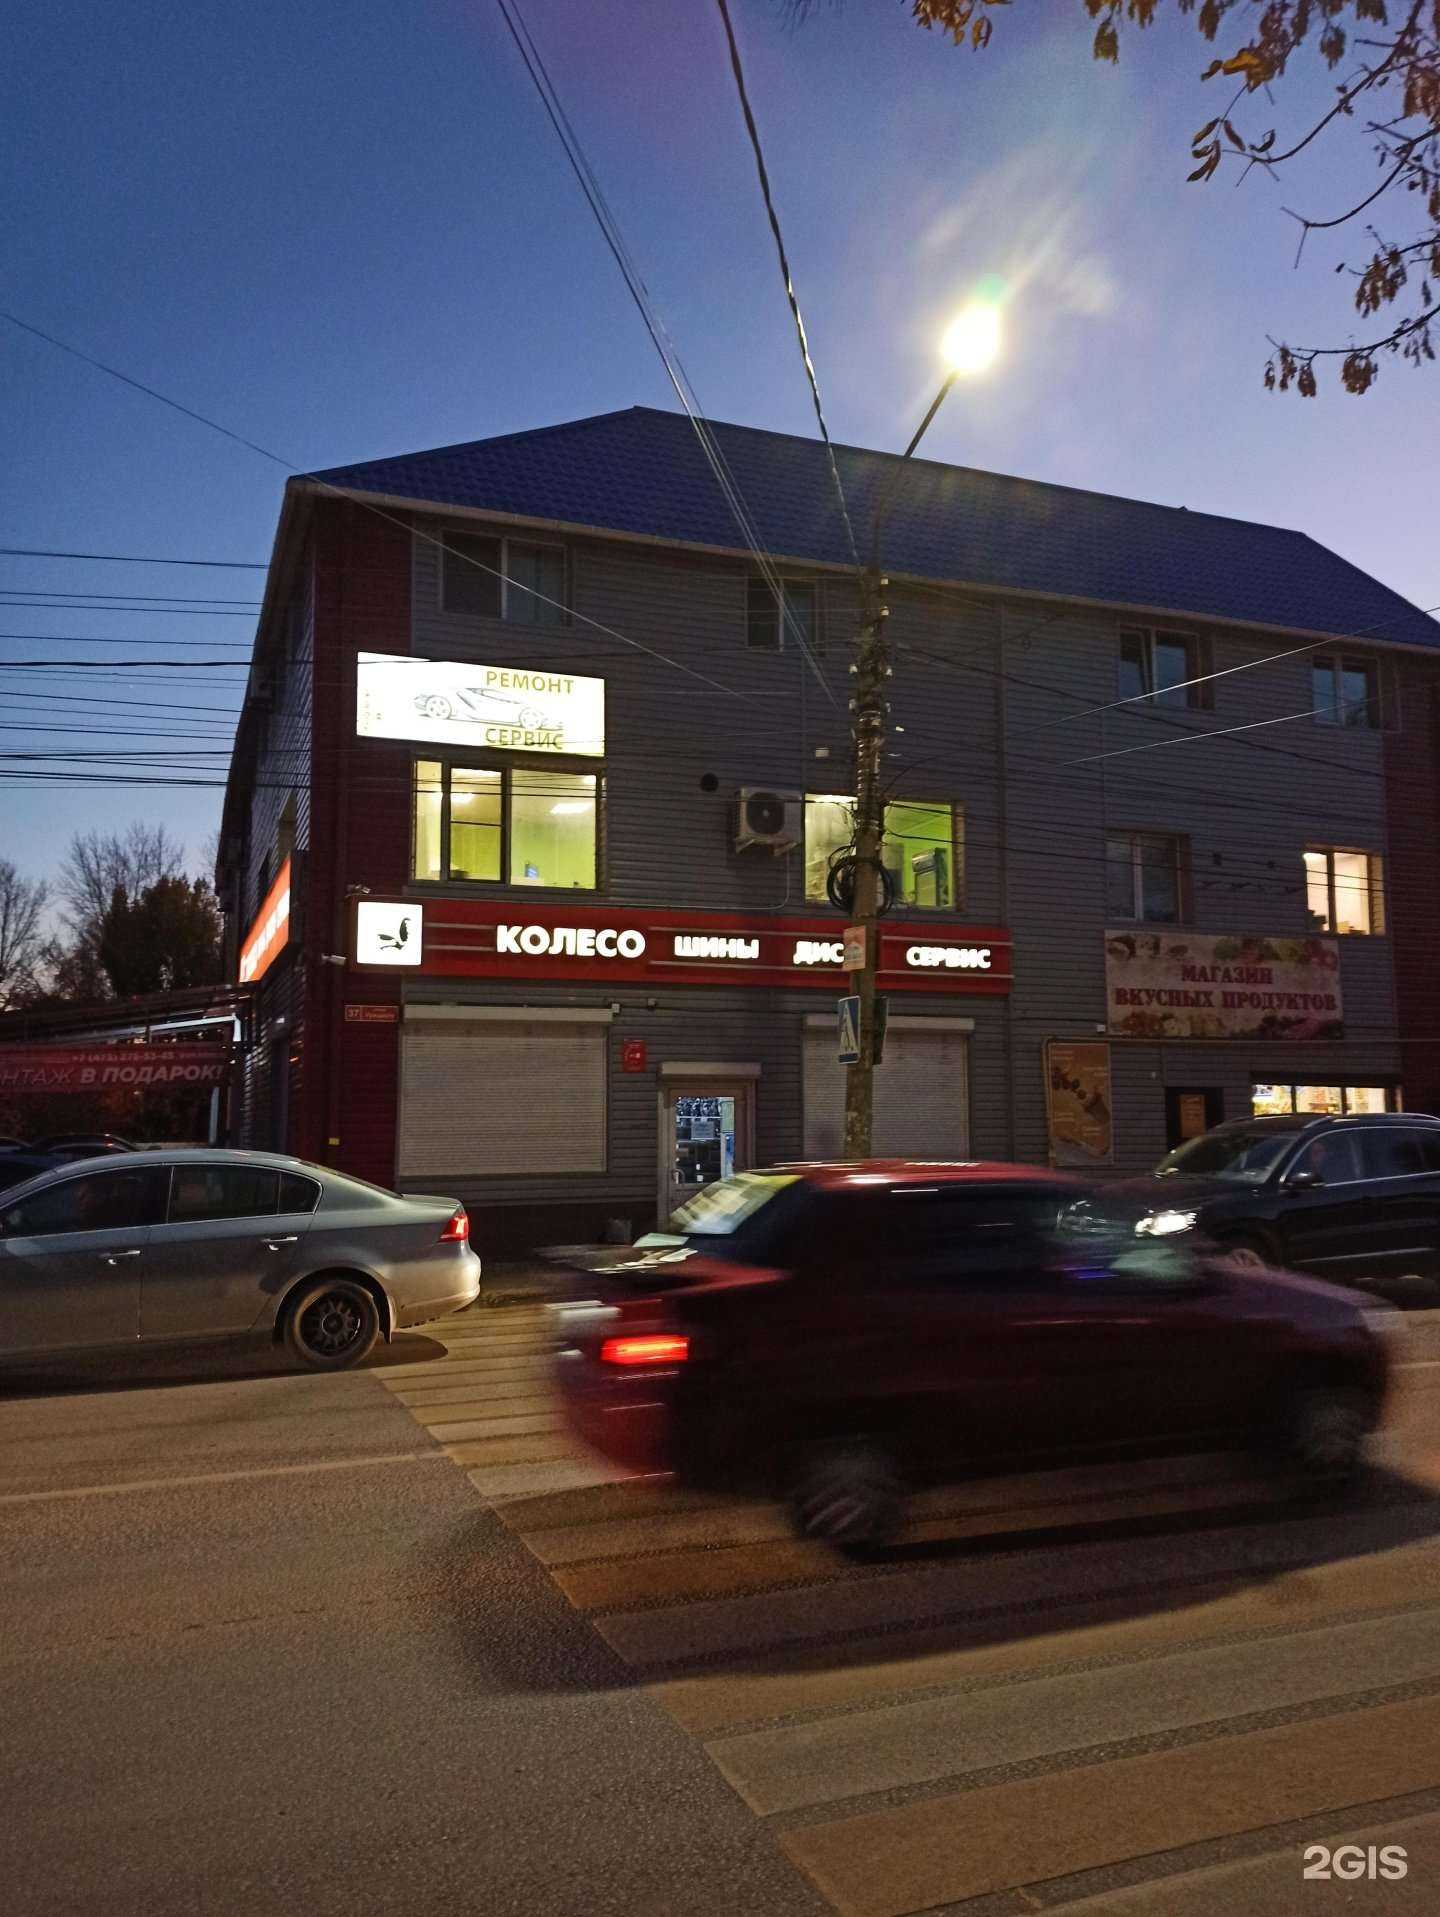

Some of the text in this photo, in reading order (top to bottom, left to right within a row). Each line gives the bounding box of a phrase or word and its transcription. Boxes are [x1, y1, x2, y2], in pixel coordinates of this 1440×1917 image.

[486, 671, 574, 694] РЕМОНТ
[485, 728, 563, 750] СЕРВИС
[496, 925, 645, 958] КОЛЕСО
[674, 935, 991, 969] ШИНЫ ДИС СЕРВИС
[1181, 964, 1274, 985] МАГАЗИН
[1114, 987, 1337, 1012] ВКУСНЫХ ПРОДУКТОВ
[0, 1063, 225, 1087] НТАЖ В ПОДАРОК!
